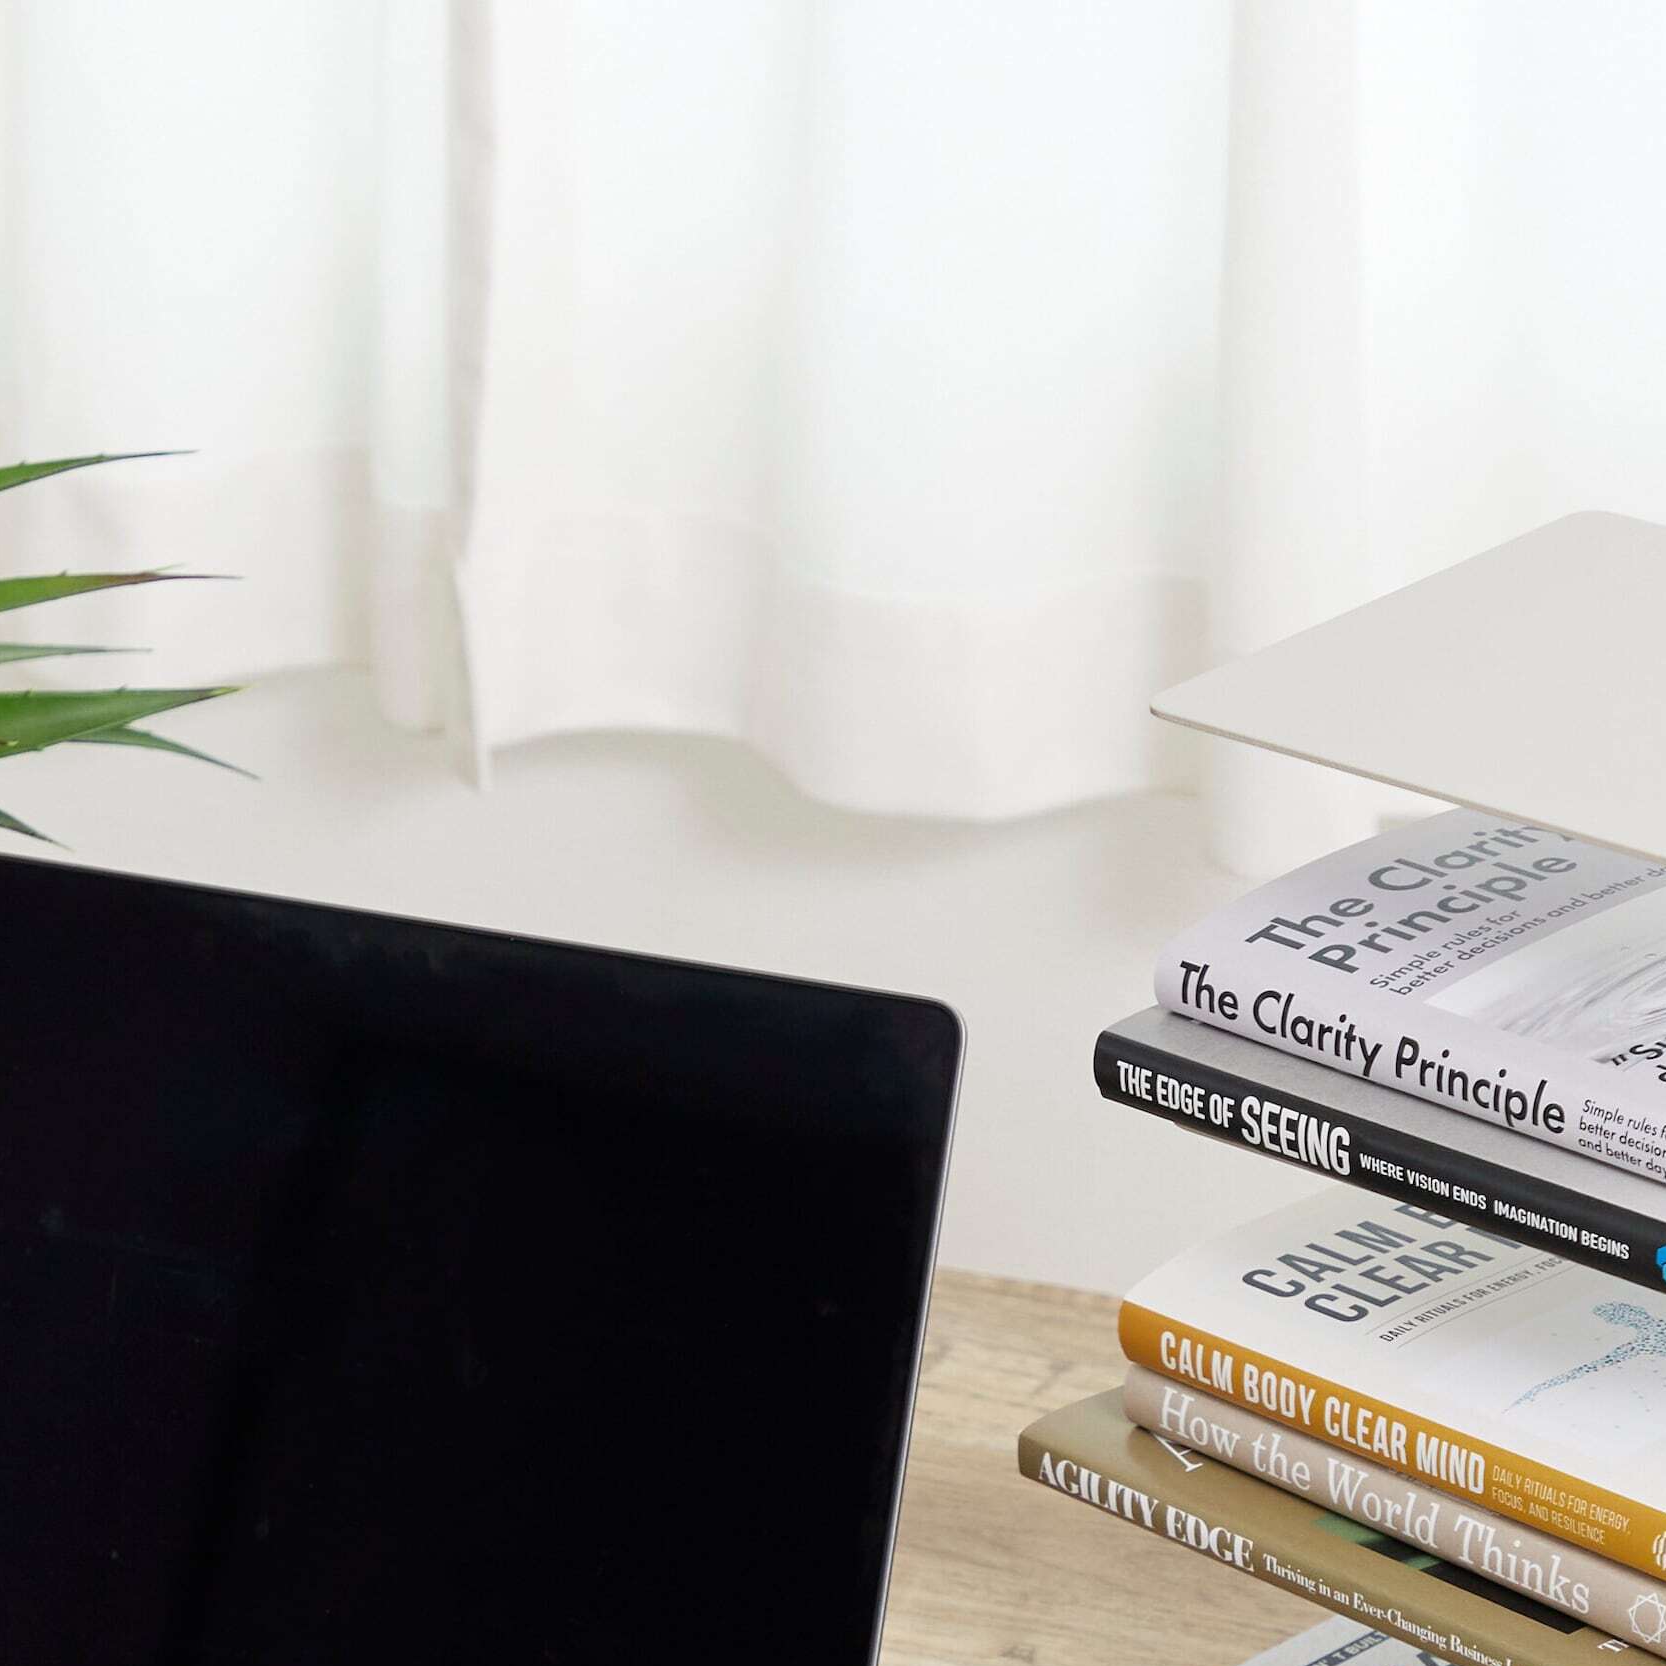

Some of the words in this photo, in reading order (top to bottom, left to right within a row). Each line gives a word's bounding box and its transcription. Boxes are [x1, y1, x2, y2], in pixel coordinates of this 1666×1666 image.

[1245, 897, 1375, 950] The
[1308, 853, 1577, 974] Principle
[1179, 960, 1239, 1022] The
[1252, 989, 1383, 1077] Clarity
[1395, 1036, 1566, 1135] Principle
[1578, 1136, 1603, 1154] and
[1605, 1141, 1642, 1166] better
[1579, 1117, 1616, 1140] better
[1582, 1099, 1624, 1131] Simple
[1628, 1115, 1658, 1138] rules
[1117, 1059, 1153, 1101] THE
[1156, 1074, 1206, 1122] EDGE
[1210, 1096, 1235, 1129] OF
[1240, 1095, 1351, 1177] SEEING
[1359, 1153, 1404, 1181] WHERE
[1407, 1167, 1449, 1198] VISION
[1453, 1183, 1487, 1210] ENDS
[1493, 1200, 1578, 1243] IMAGINATION
[1580, 1228, 1630, 1260] BEGINS
[1242, 1220, 1417, 1298] CALM
[1304, 1240, 1495, 1323] CLEAR
[1159, 1330, 1234, 1396] CALM
[1242, 1362, 1313, 1427] BODY
[1324, 1396, 1408, 1460] CLEAR
[1416, 1434, 1485, 1495] MIND
[1158, 1386, 1242, 1463] How
[1251, 1429, 1312, 1491] the
[1326, 1457, 1440, 1549] World
[1453, 1515, 1592, 1615] Thinks
[1492, 1465, 1522, 1489] DAILY
[1523, 1478, 1566, 1508] RITUALS
[1567, 1495, 1587, 1516] FOR
[1528, 1502, 1550, 1522] AND
[1550, 1510, 1605, 1545] RESILIENCE
[1037, 1451, 1160, 1531] AGILITY
[1165, 1506, 1256, 1574] EDGE
[1262, 1552, 1317, 1599] Thriving
[1317, 1576, 1332, 1595] in
[1334, 1587, 1350, 1604] an
[1352, 1592, 1449, 1651] Ever-Changing
